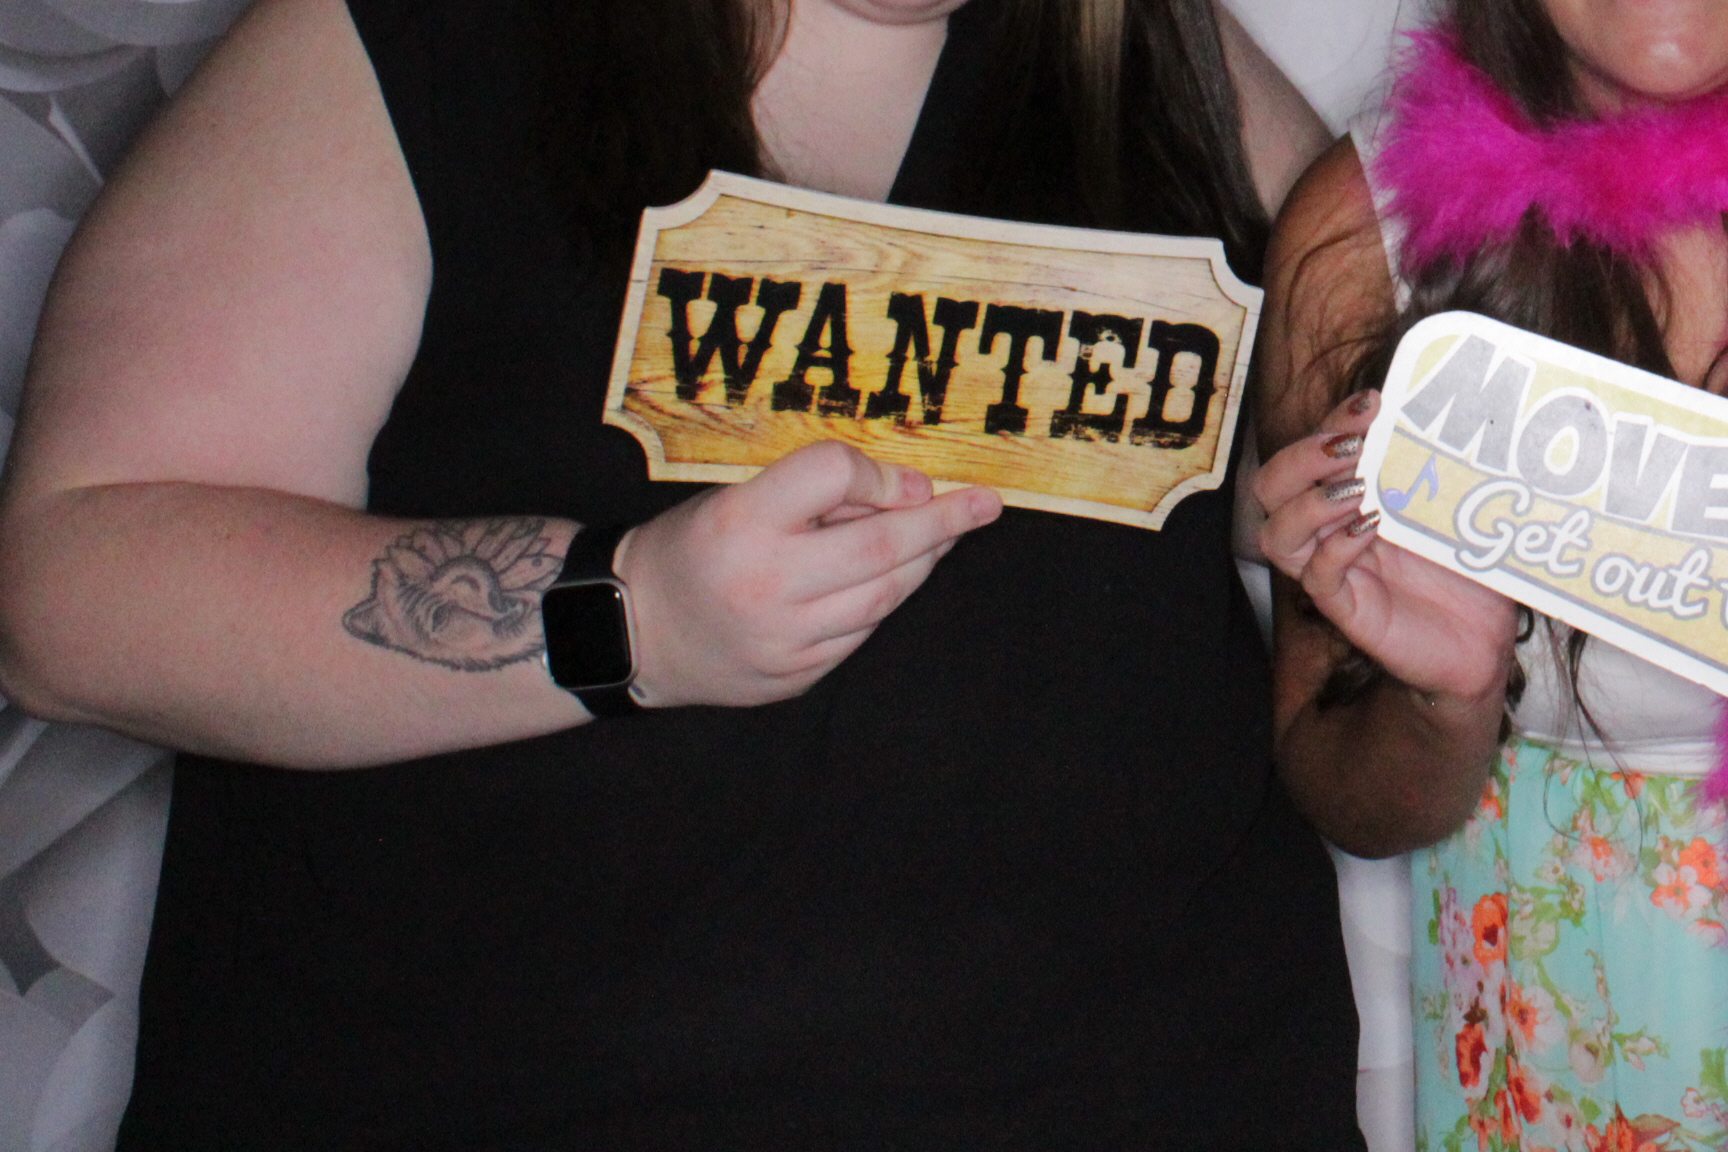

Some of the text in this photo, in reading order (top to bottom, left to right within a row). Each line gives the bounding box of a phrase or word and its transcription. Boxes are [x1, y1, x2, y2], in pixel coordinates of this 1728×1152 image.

[657, 267, 1221, 449] WANTED
[1454, 477, 1593, 573] Get
[1591, 545, 1713, 620] out
